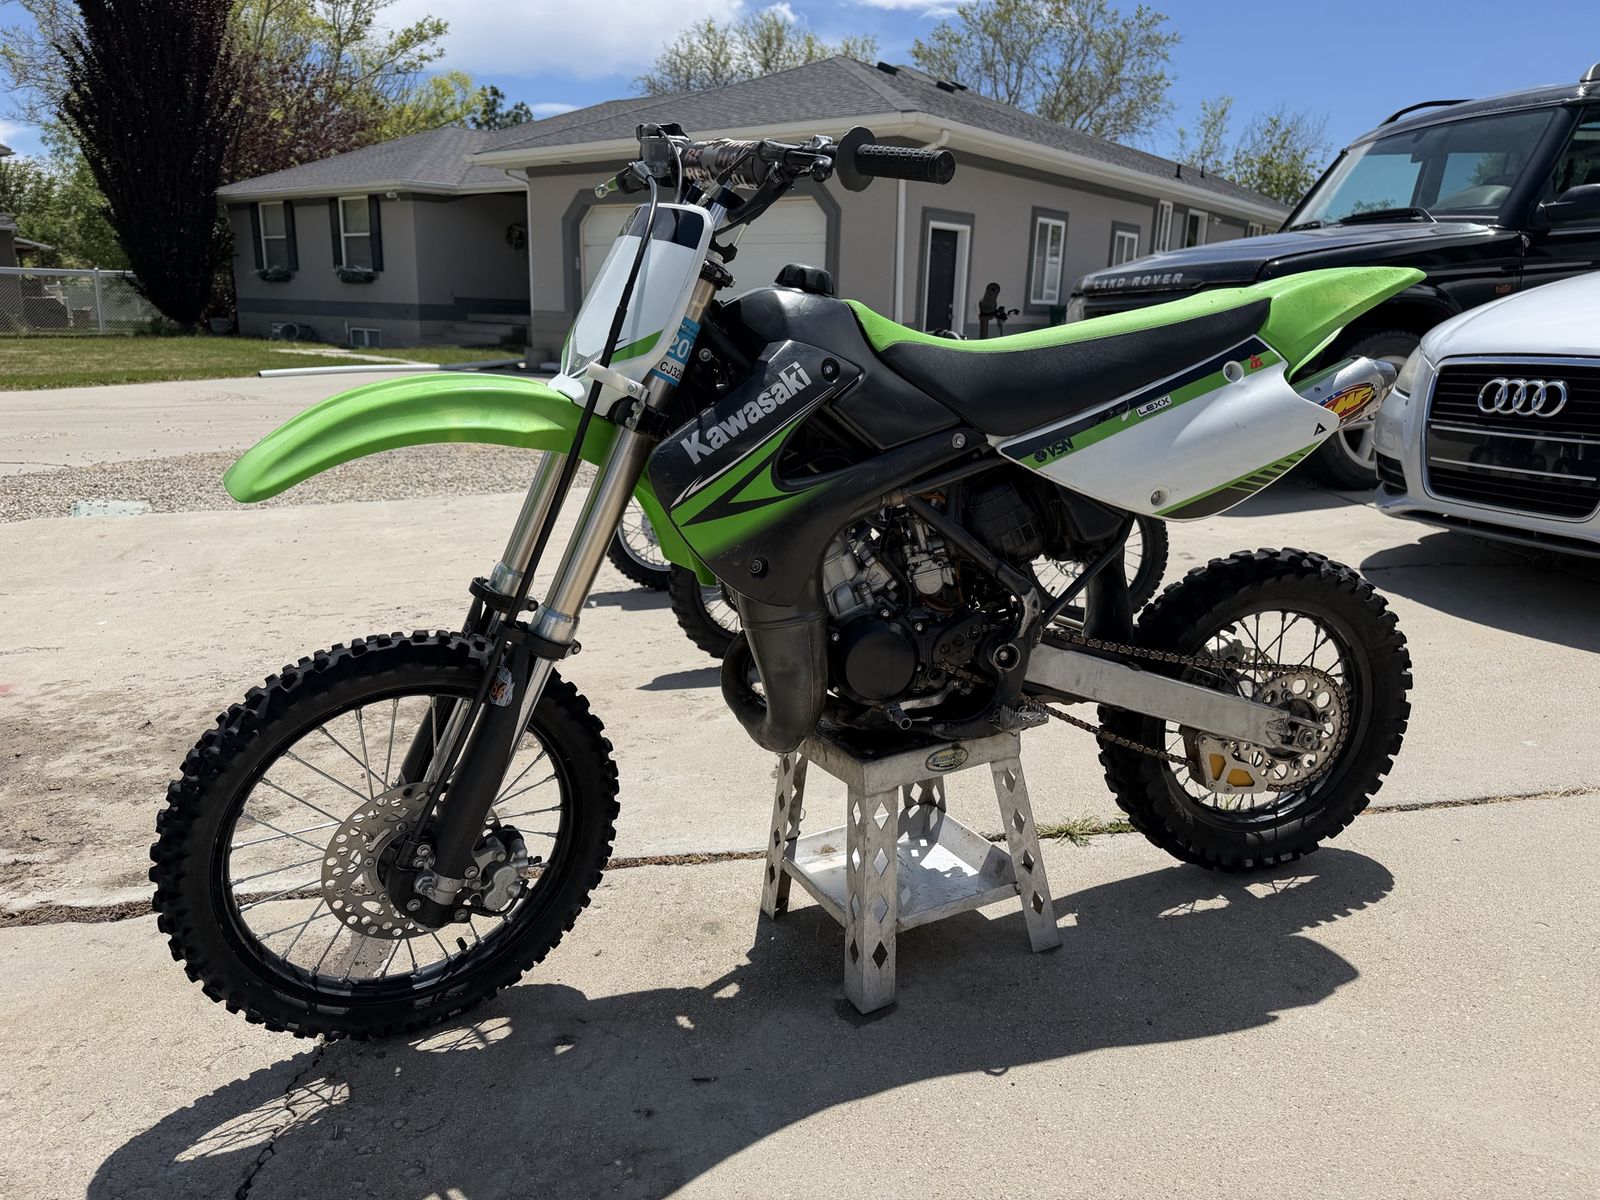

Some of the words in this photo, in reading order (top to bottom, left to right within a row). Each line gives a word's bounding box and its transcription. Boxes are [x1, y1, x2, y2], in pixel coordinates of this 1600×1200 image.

[1094, 278, 1125, 290] LAND
[1132, 273, 1183, 287] ROVER
[680, 361, 812, 465] Kawasaki
[1137, 397, 1170, 415] LEXX
